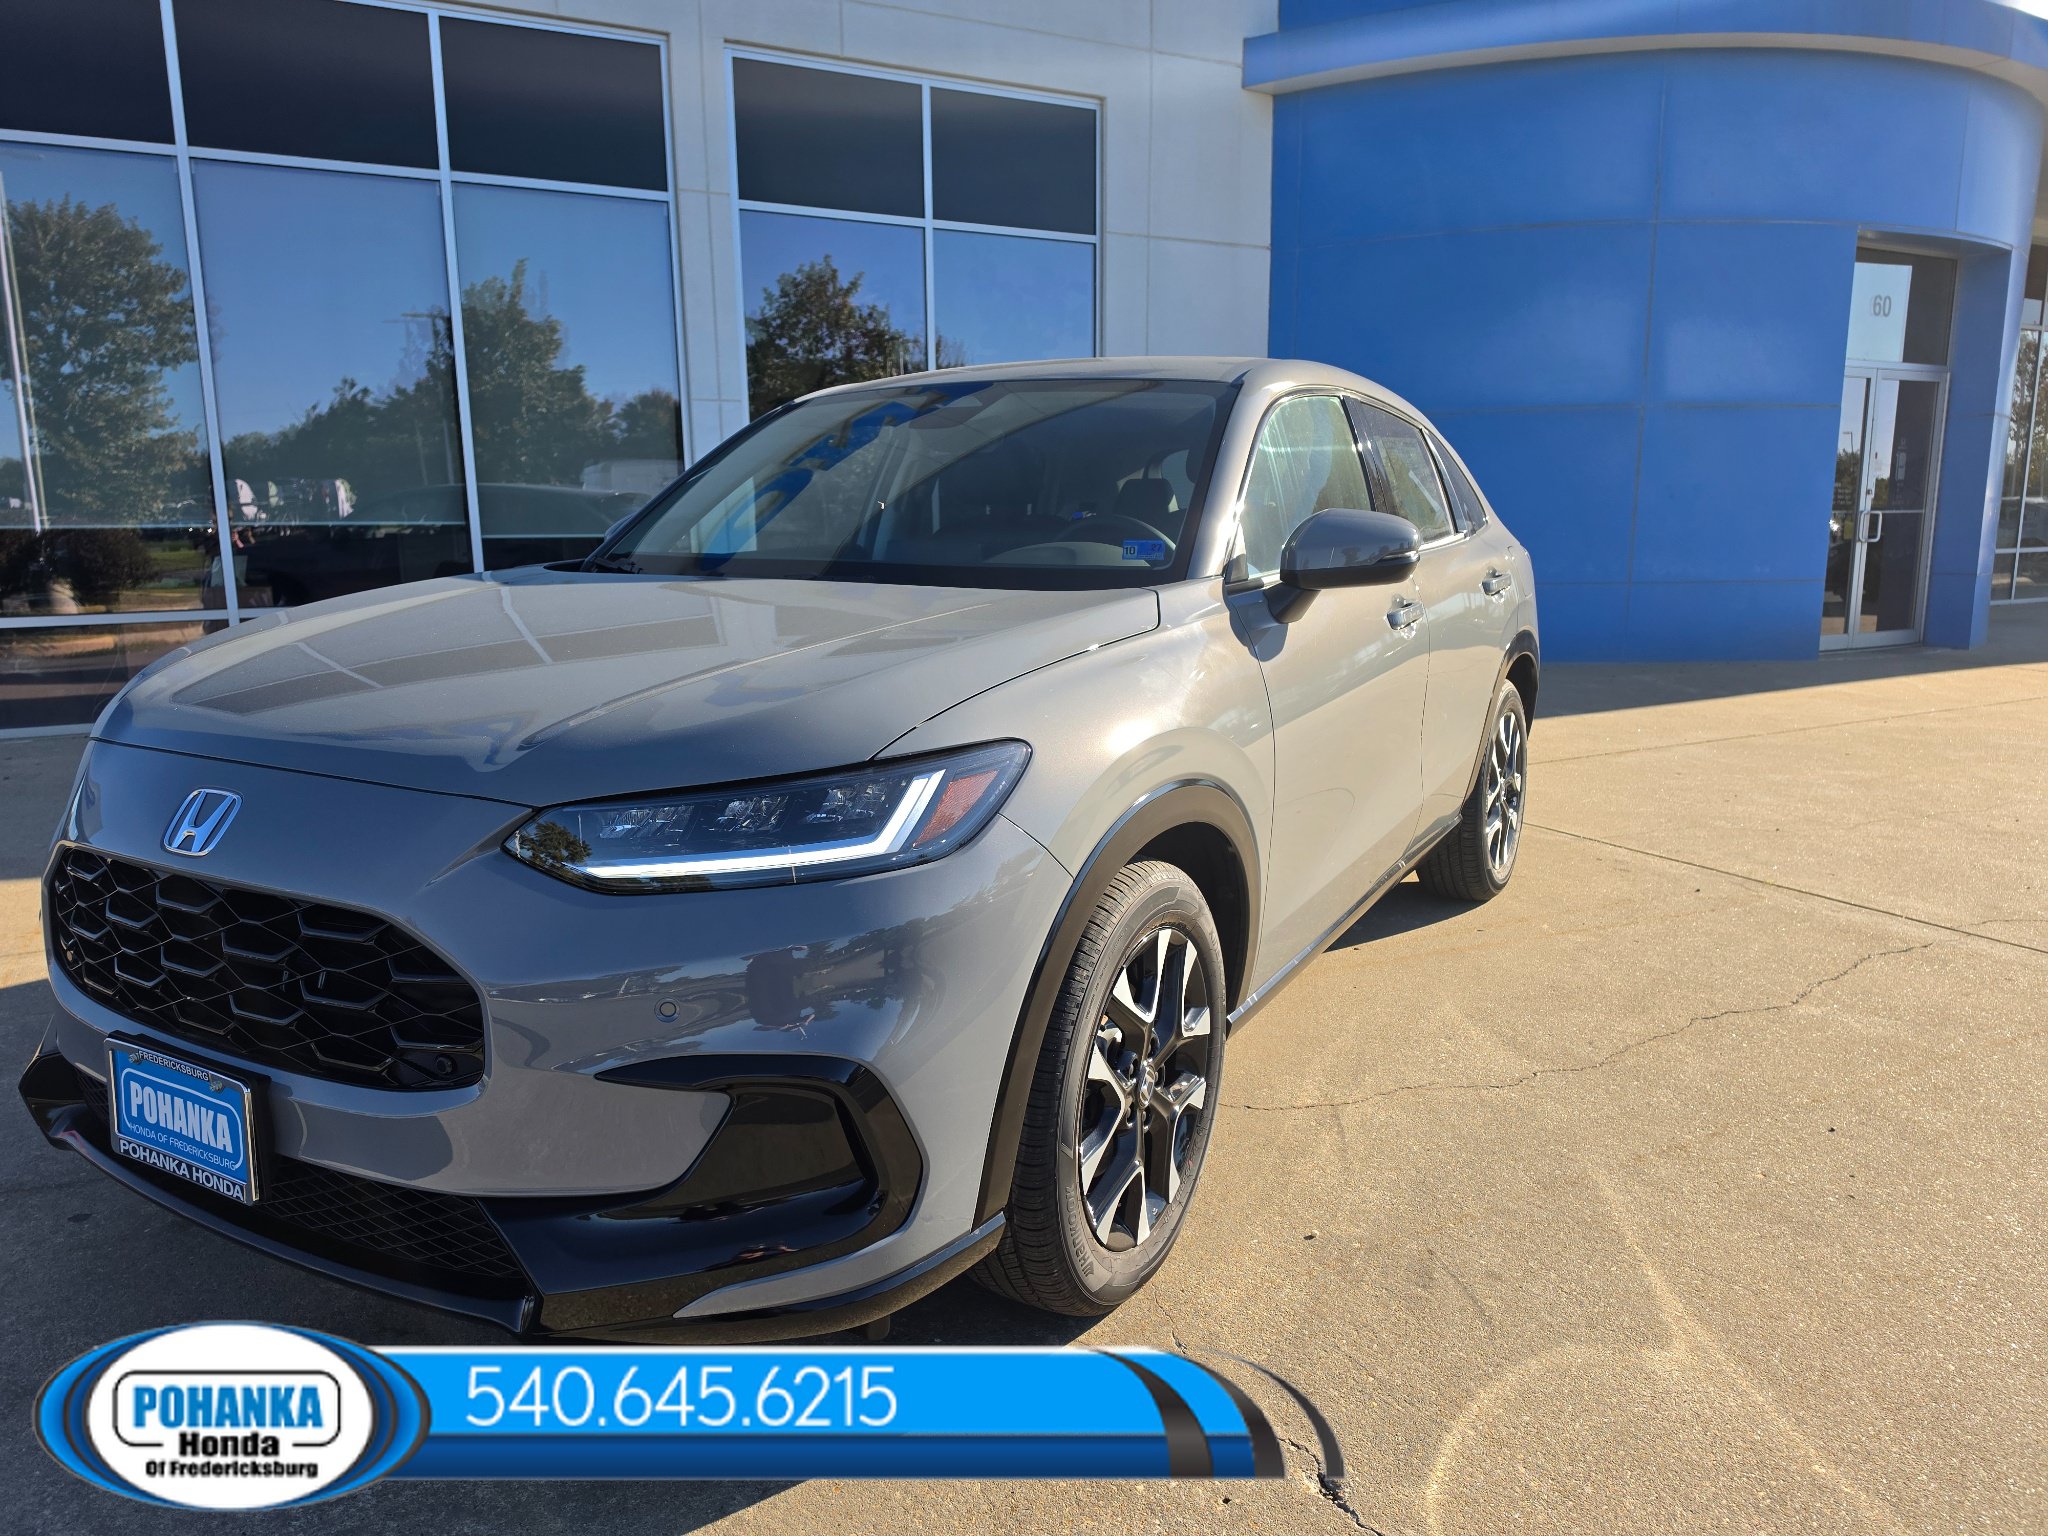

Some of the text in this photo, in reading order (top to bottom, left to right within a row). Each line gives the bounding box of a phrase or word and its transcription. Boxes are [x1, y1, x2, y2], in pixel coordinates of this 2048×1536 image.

[1873, 294, 1892, 318] 60
[1123, 546, 1136, 555] 10
[139, 1050, 209, 1082] FREDERICKSBURG
[130, 1080, 233, 1154] POHANKA
[129, 1122, 237, 1172] HONDA OF FREDERICKSBURG
[119, 1139, 244, 1201] POHANKA HONDA
